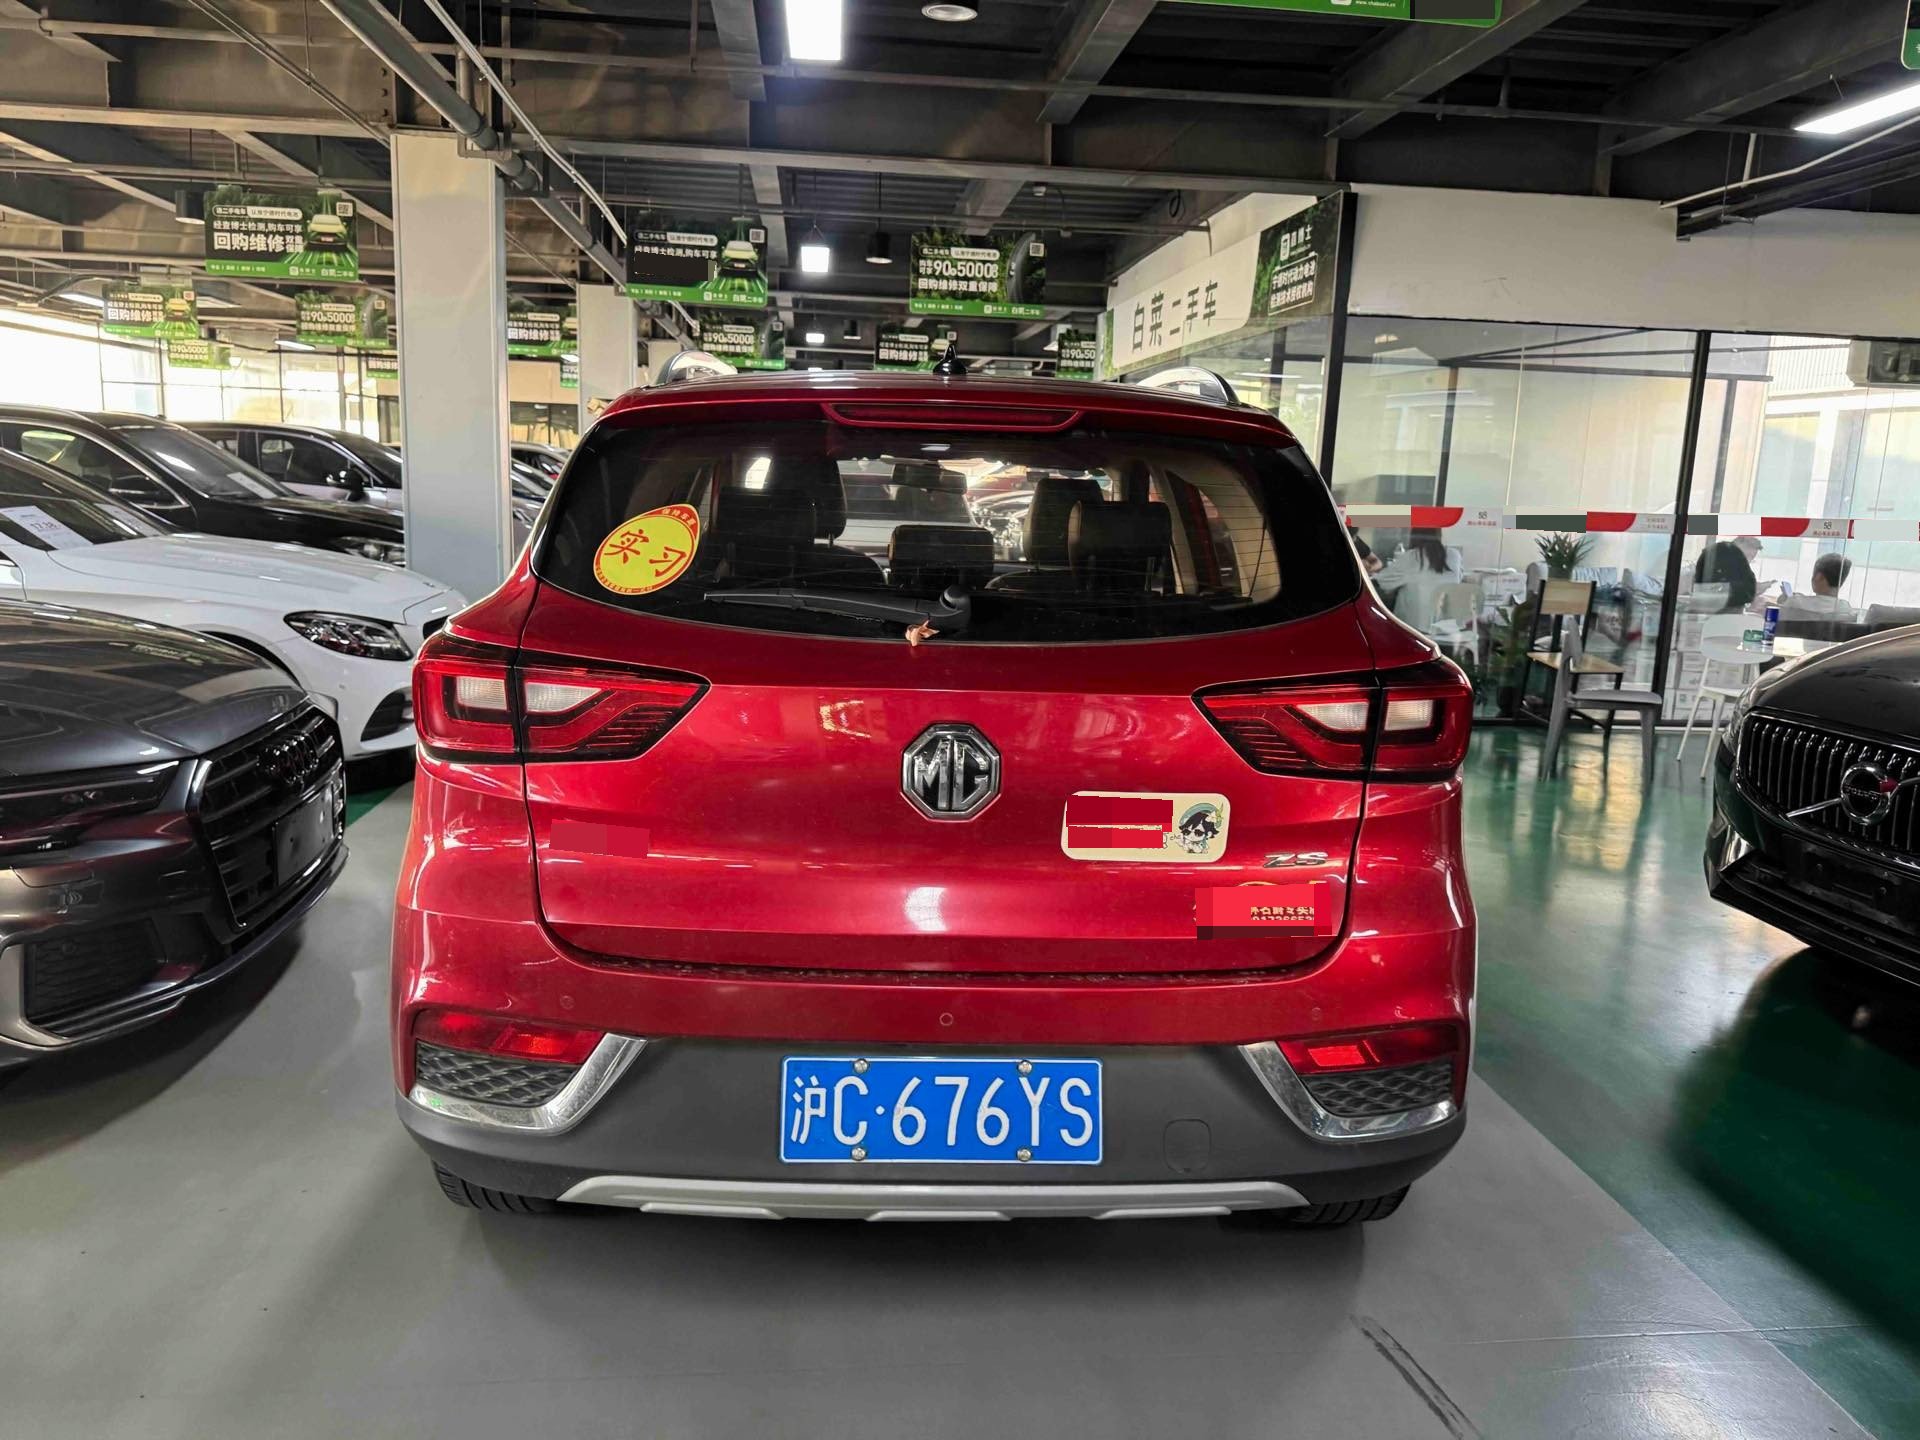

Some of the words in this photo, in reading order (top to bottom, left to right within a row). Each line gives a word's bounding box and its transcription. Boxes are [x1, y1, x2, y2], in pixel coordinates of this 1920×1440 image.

[213, 231, 284, 252] 回购维修
[1132, 280, 1218, 354] 白菜二手车
[914, 739, 989, 811] MG
[1263, 852, 1329, 868] ZS
[791, 1075, 1094, 1147] 沪C·676YS
